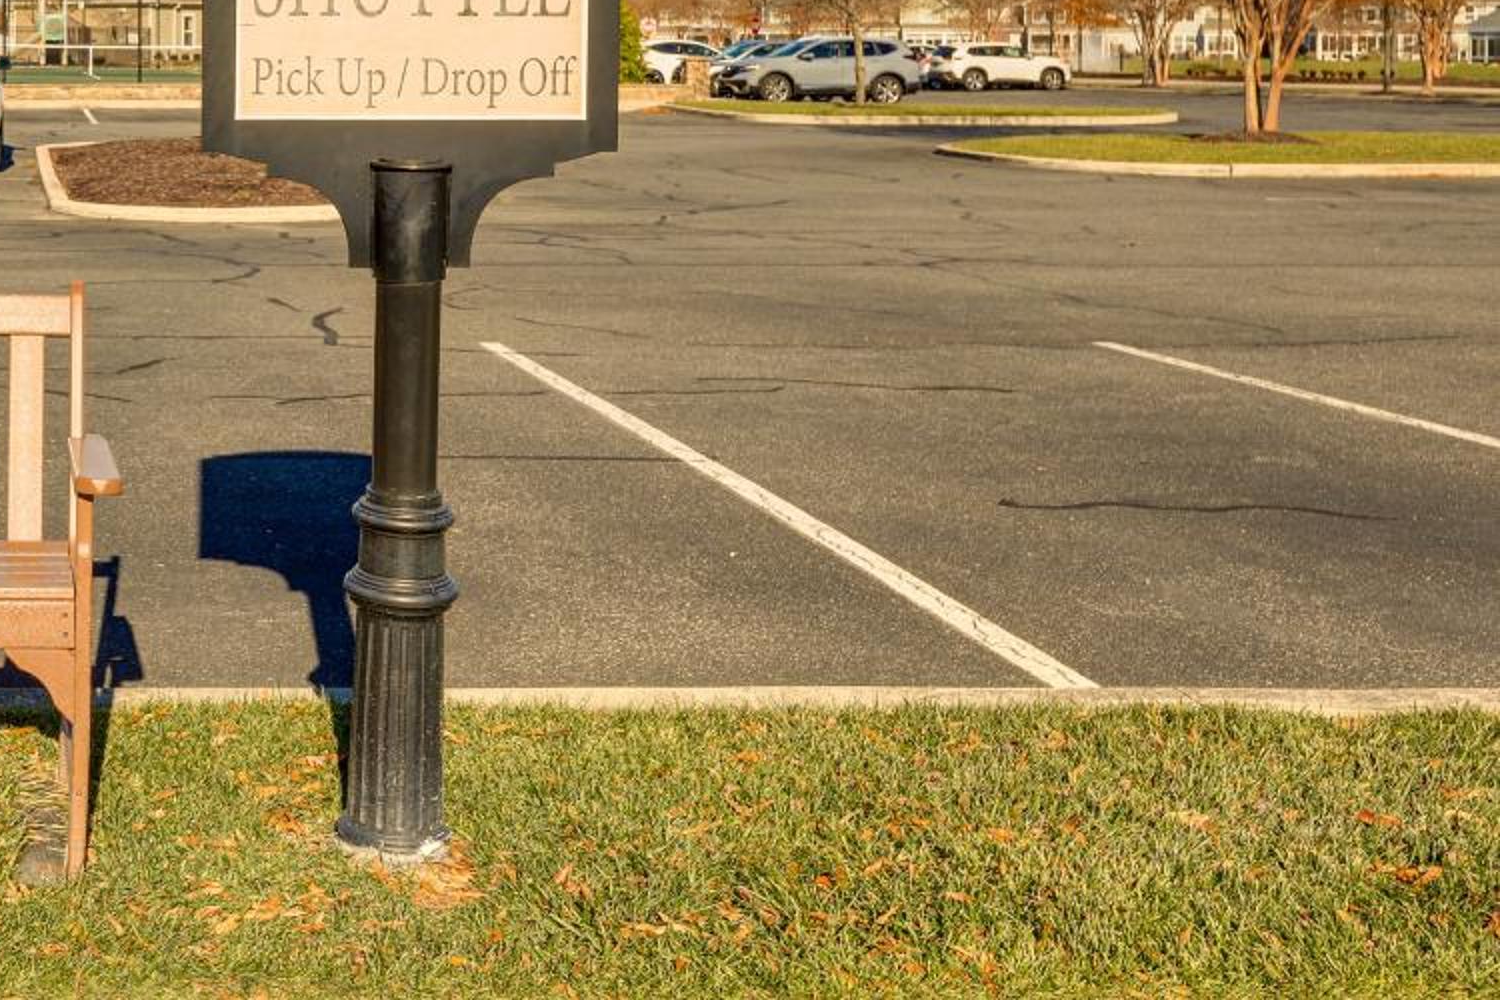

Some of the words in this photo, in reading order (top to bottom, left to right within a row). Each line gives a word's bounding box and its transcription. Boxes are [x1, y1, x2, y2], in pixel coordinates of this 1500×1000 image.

[252, 56, 325, 96] Pick
[336, 57, 386, 108] Up
[396, 57, 410, 98] /
[421, 57, 506, 108] Drop
[519, 56, 576, 96] Off
